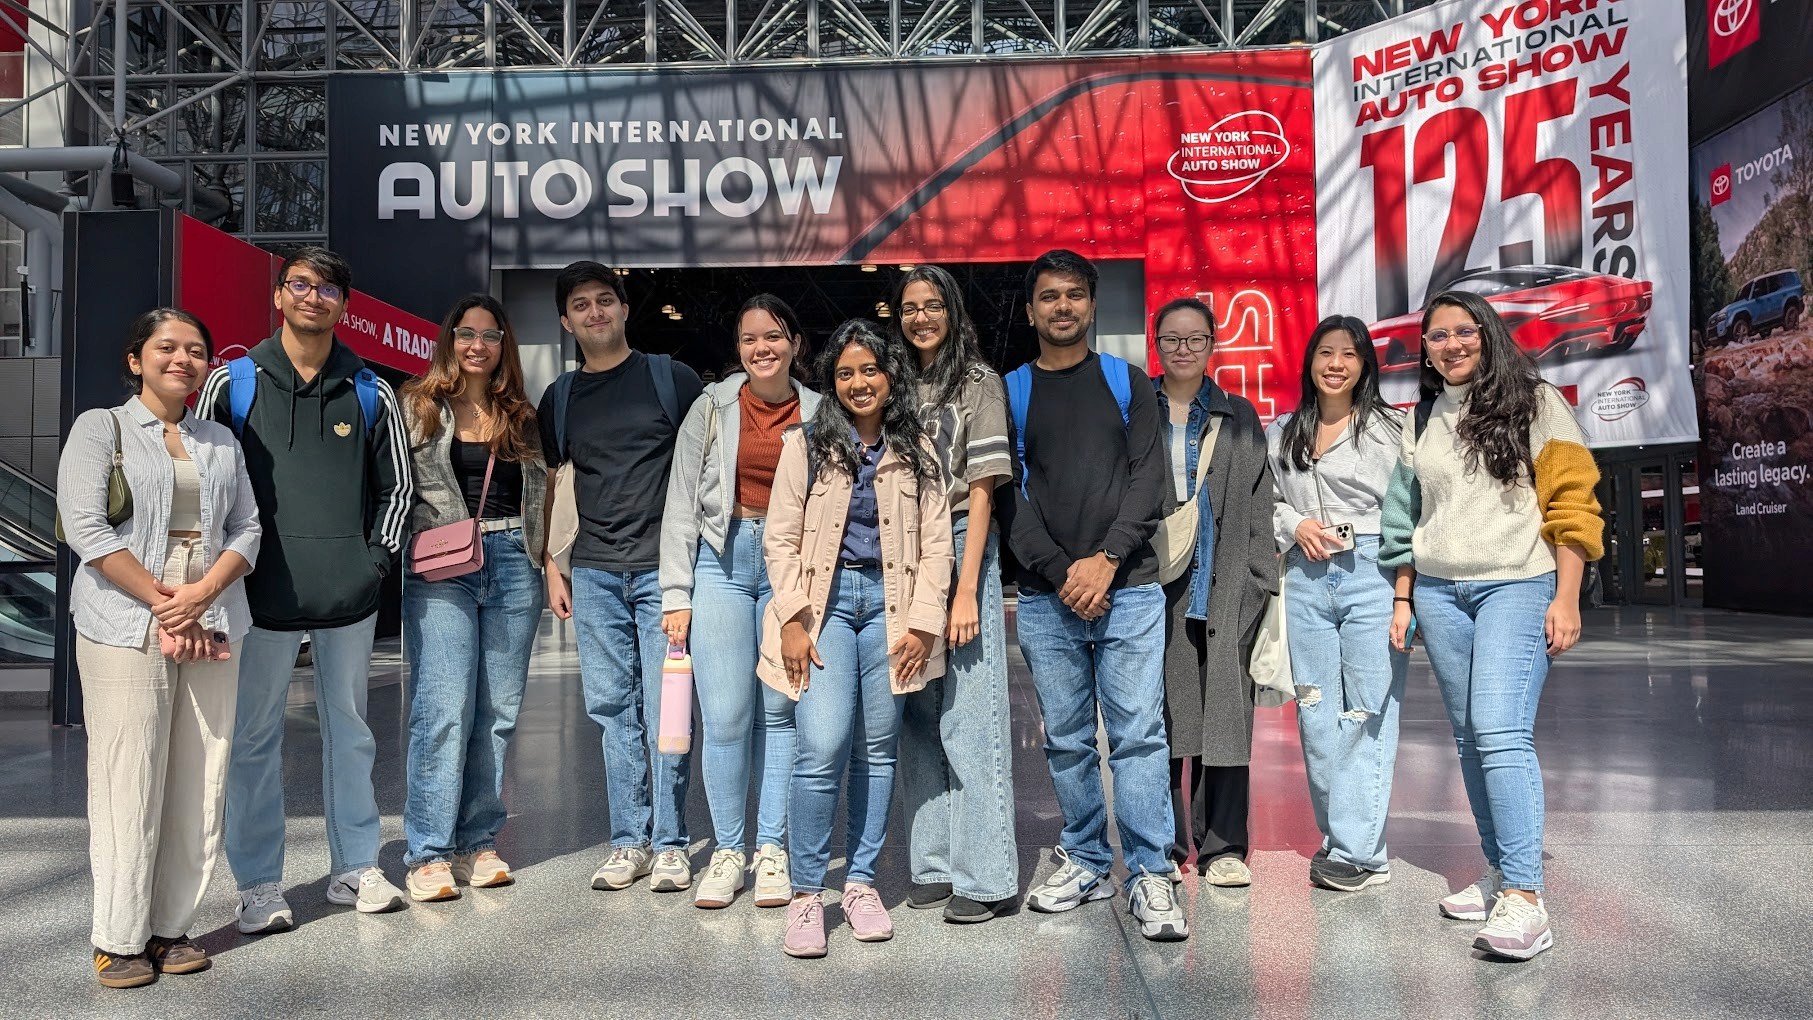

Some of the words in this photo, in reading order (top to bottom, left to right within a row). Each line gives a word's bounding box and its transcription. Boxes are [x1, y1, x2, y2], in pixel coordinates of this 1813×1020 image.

[1353, 22, 1463, 82] NEW
[1479, 0, 1622, 39] YOR
[1354, 8, 1628, 102] INTERNATIONAL
[1355, 76, 1464, 128] AUTO
[1477, 26, 1629, 92] SHOW
[379, 122, 452, 147] NEW
[465, 121, 558, 147] YORK
[572, 116, 843, 144] INTERNATIONAL
[1181, 132, 1212, 143] NEW
[1214, 131, 1250, 143] YORK
[1181, 144, 1281, 157] INTERNATIONAL
[1182, 160, 1218, 172] AUTO
[1221, 158, 1260, 171] SHOW
[1735, 143, 1793, 184] TOYOTA
[1589, 61, 1637, 281] YEARS
[378, 158, 593, 221] AUTO
[606, 155, 843, 218] SHOW
[1359, 77, 1583, 320] 125
[342, 311, 351, 327] A
[350, 314, 378, 339] SHOW,
[382, 322, 394, 348] A
[1597, 394, 1646, 404] INTERNATIONAL
[1616, 402, 1636, 410] SHOW
[1732, 440, 1774, 460] Create
[1777, 440, 1786, 454] a
[1714, 467, 1757, 488] lasting
[1759, 463, 1810, 486] legacy.
[1735, 502, 1757, 516] Land
[1756, 501, 1787, 515] Cruiser
